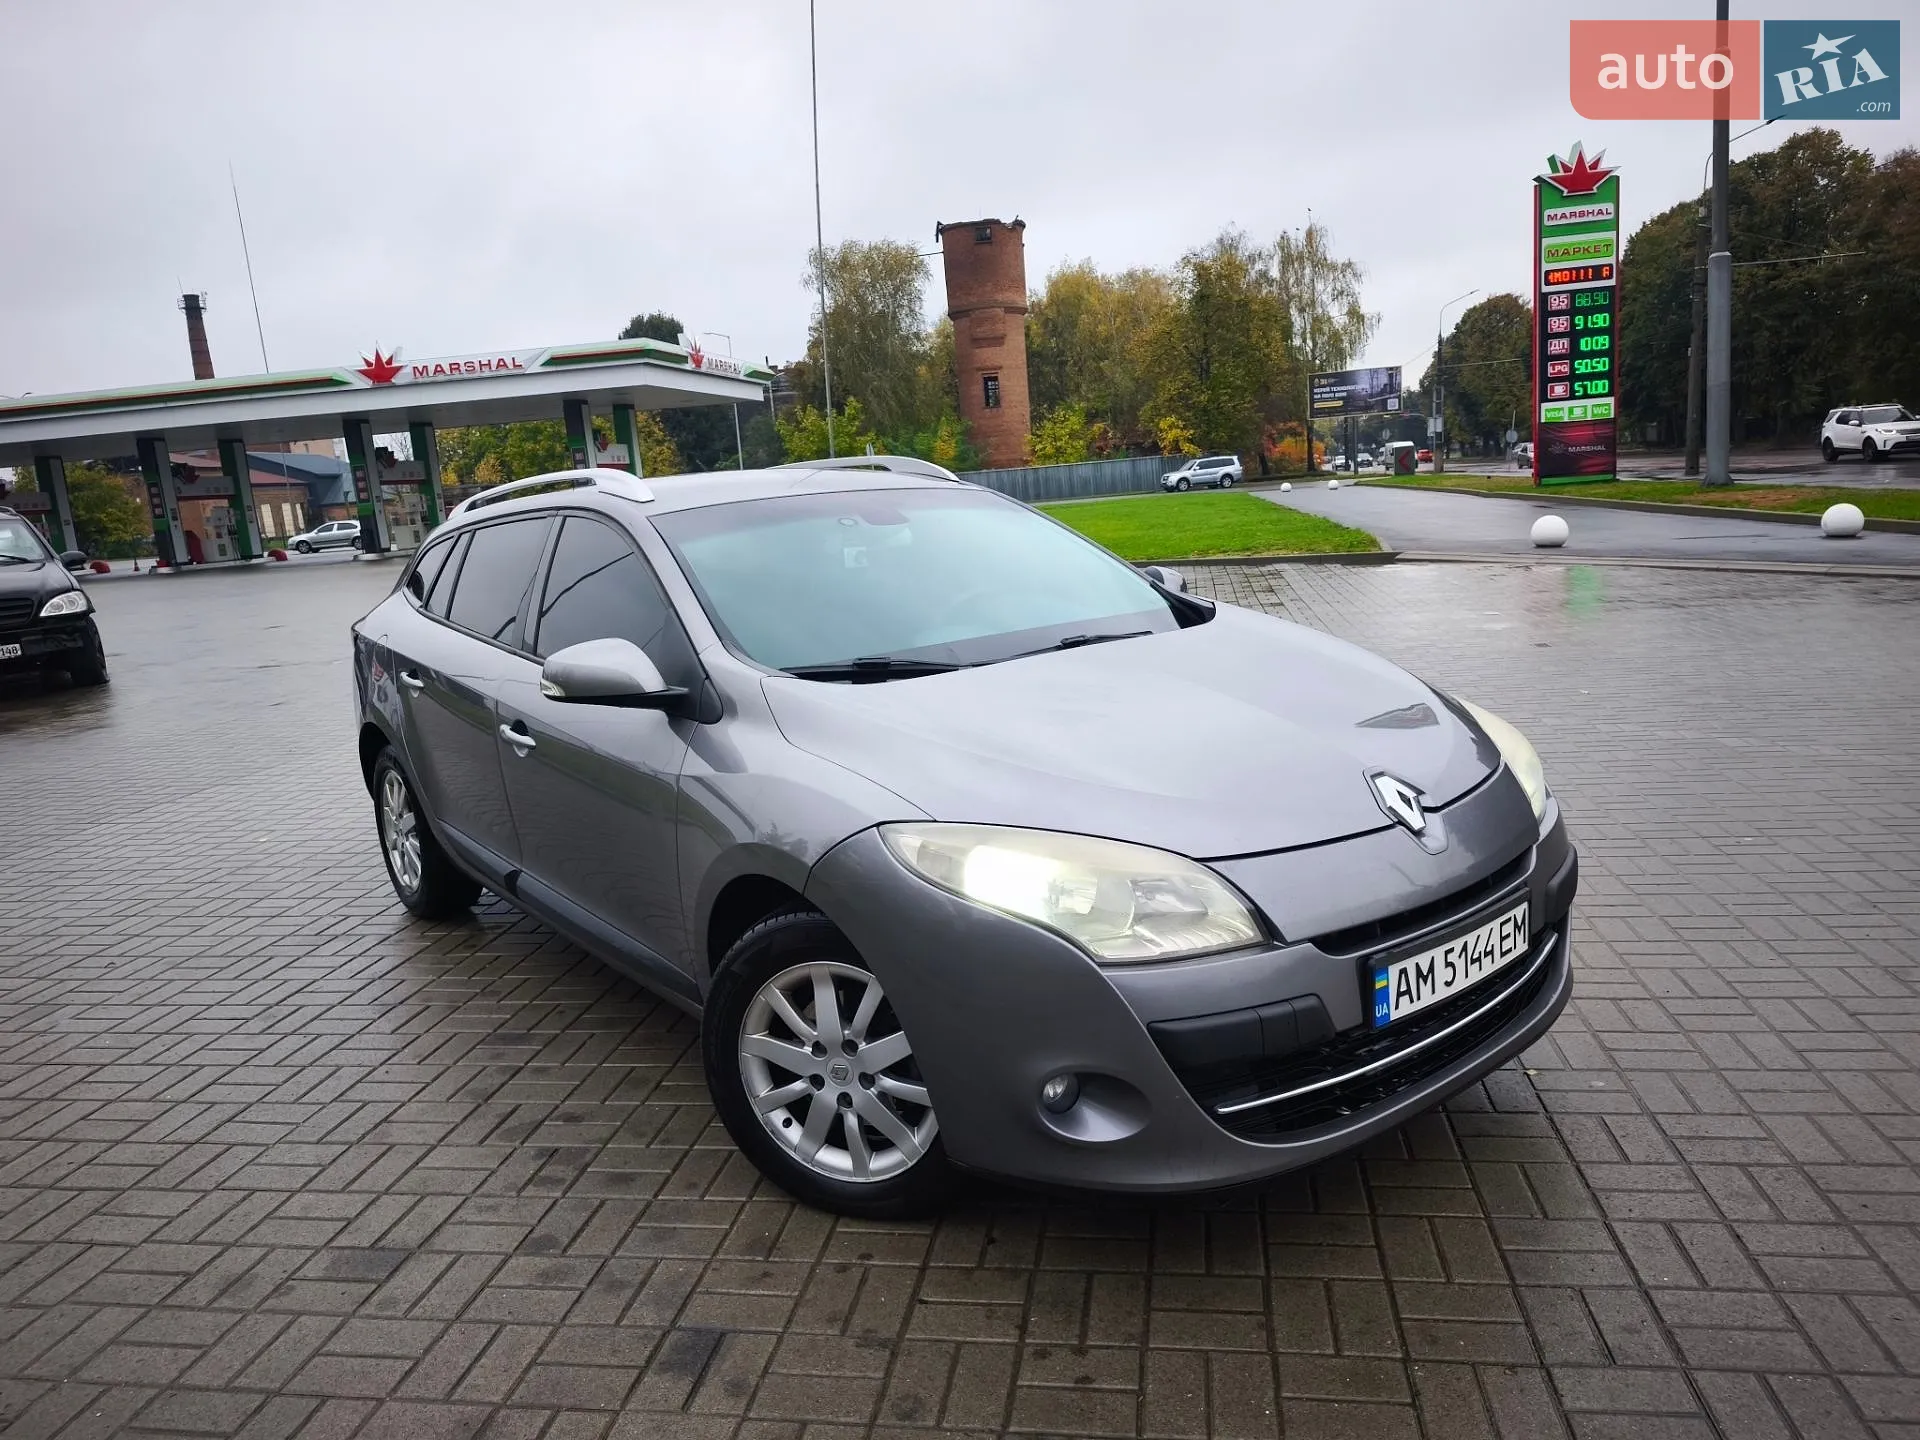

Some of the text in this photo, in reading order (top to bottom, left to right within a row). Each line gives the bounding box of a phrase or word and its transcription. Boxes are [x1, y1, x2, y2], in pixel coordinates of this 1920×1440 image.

[1547, 207, 1612, 222] MARSHAL
[1550, 295, 1568, 307] 95
[1550, 317, 1568, 328] 95
[1550, 339, 1568, 350] ДП
[412, 357, 523, 378] MARSHAL
[1550, 364, 1568, 373] LPG
[1546, 409, 1564, 418] VISA
[1592, 406, 1609, 414] WC
[1568, 444, 1606, 453] MARSHAL
[1394, 907, 1527, 1011] AM 5144 EM
[1375, 1003, 1389, 1017] UA
